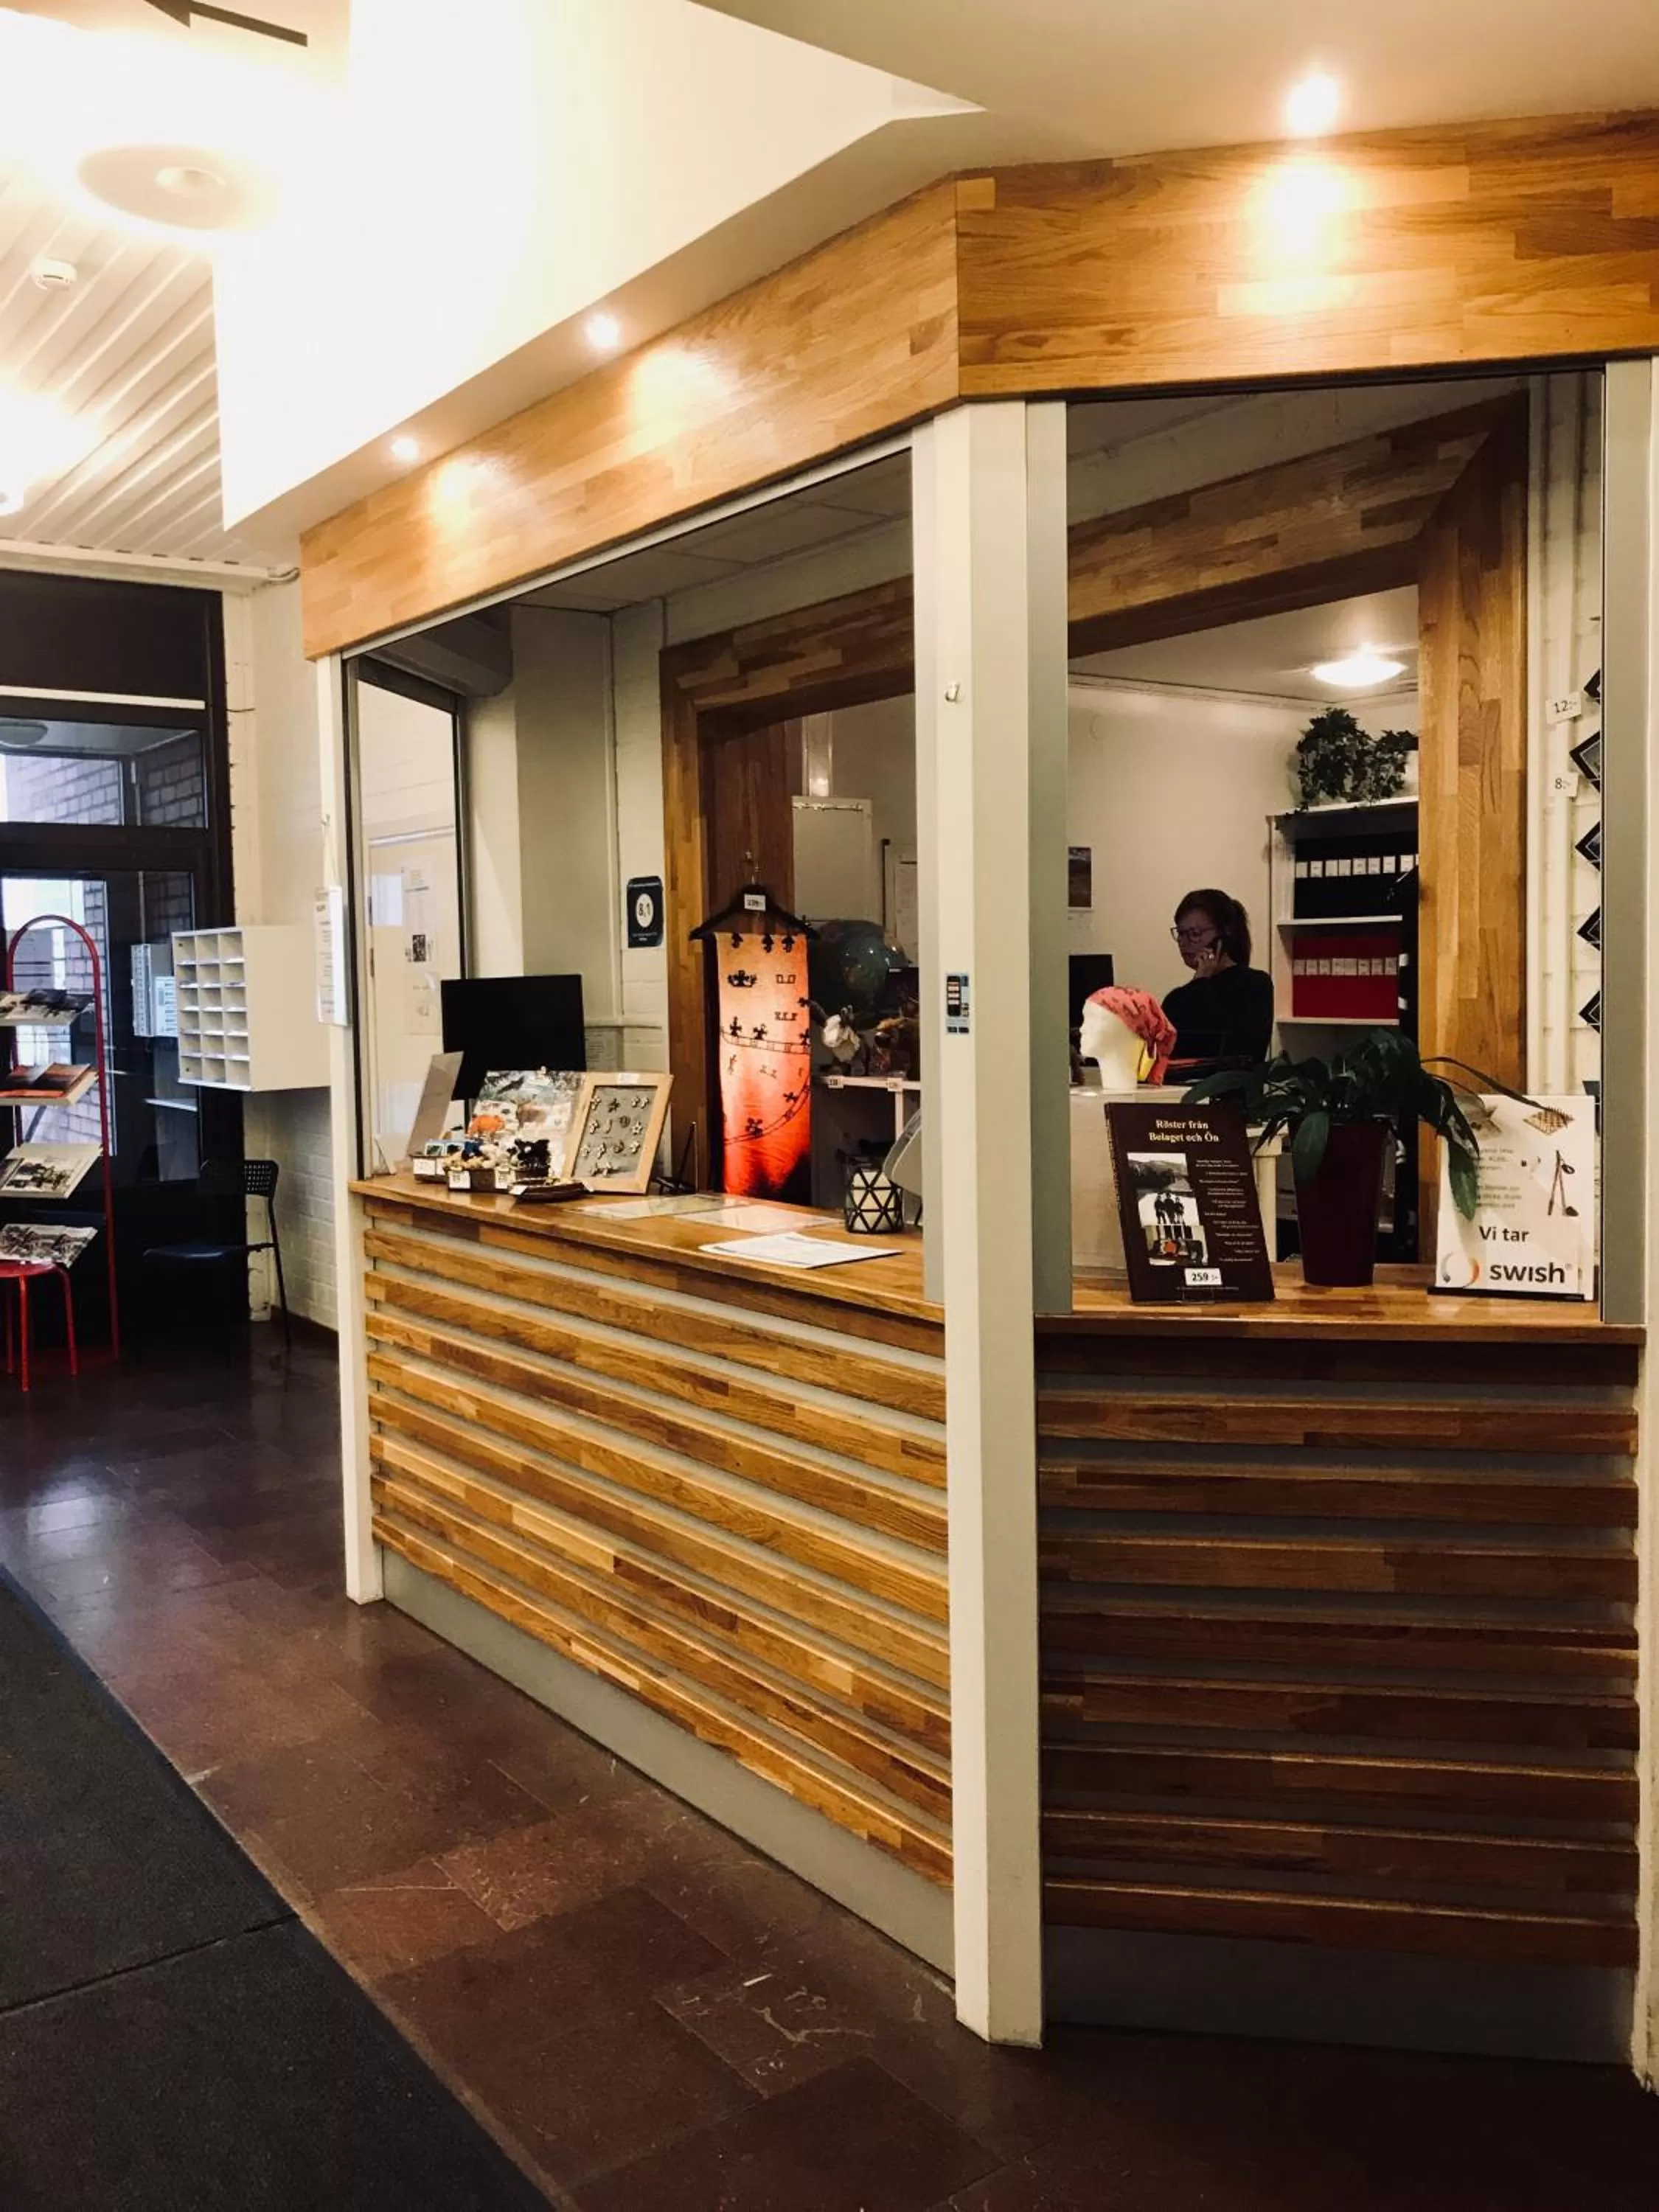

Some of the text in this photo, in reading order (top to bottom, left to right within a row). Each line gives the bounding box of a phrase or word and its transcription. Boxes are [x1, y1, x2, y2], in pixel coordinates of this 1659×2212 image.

[1189, 1120, 1208, 1129] från
[1185, 1133, 1203, 1142] och
[1478, 1226, 1529, 1242] Vi tar
[1489, 1262, 1565, 1283] swish
